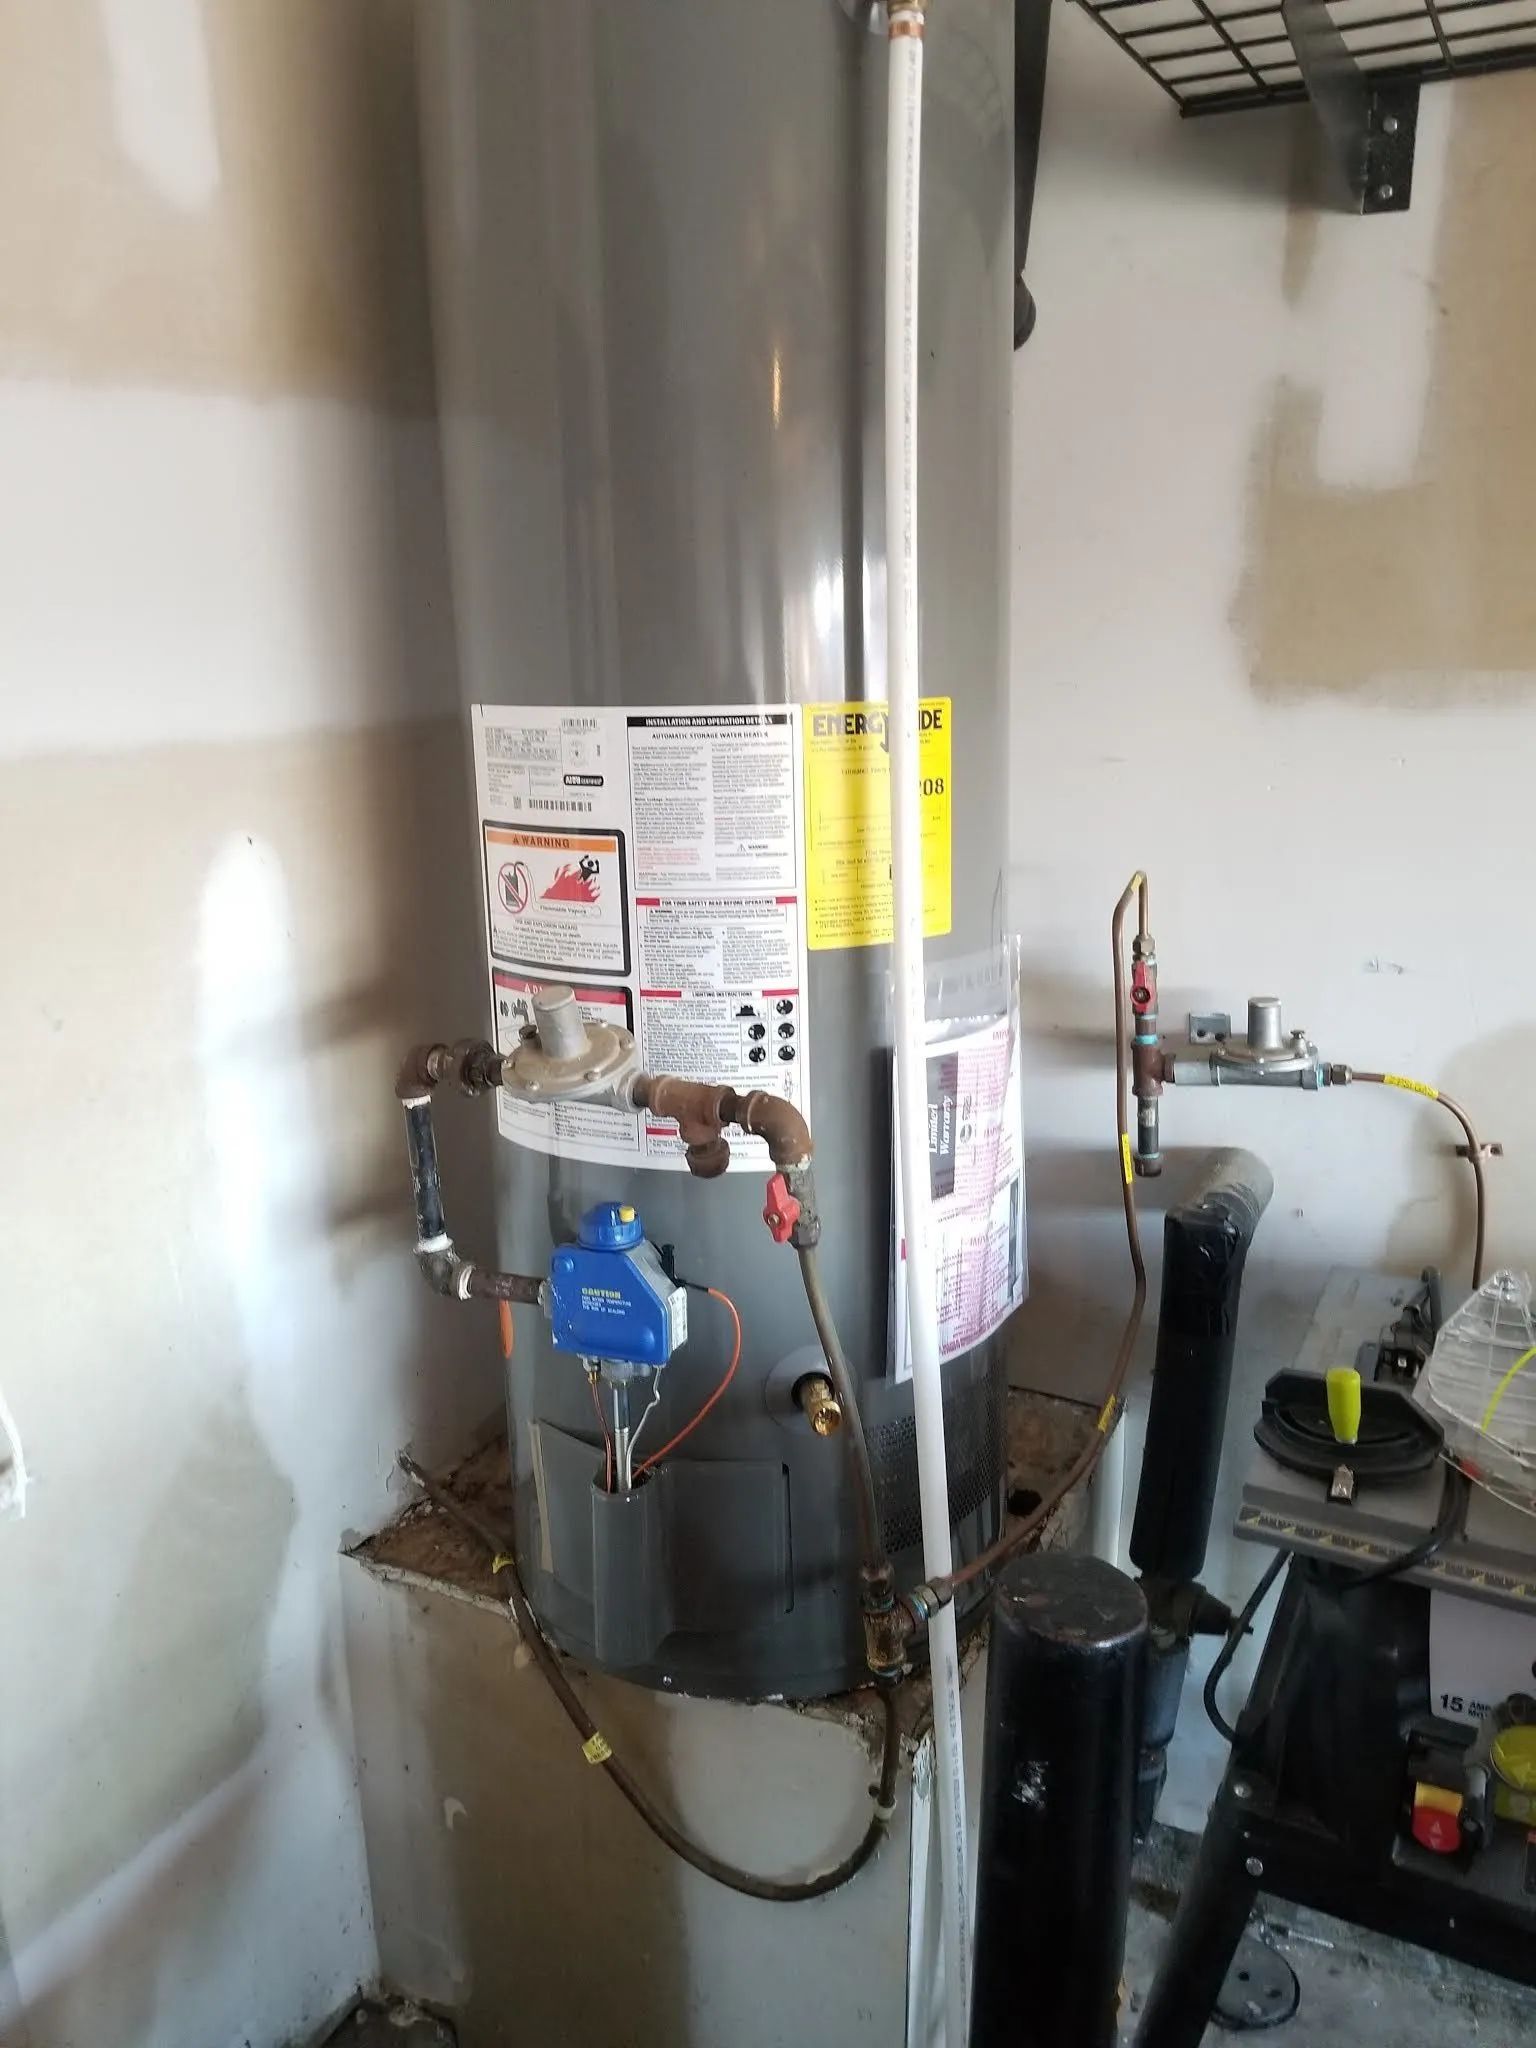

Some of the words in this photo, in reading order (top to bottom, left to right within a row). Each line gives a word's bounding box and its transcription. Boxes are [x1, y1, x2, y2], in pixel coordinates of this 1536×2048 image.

[645, 717, 691, 726] INSTALLATION
[691, 717, 706, 726] AND
[707, 716, 745, 726] OPERATION
[521, 836, 570, 849] WARNING
[927, 1103, 939, 1154] Limited
[939, 1095, 954, 1156] Warranty
[581, 1287, 621, 1300] CAUTION
[1440, 1694, 1464, 1712] 15
